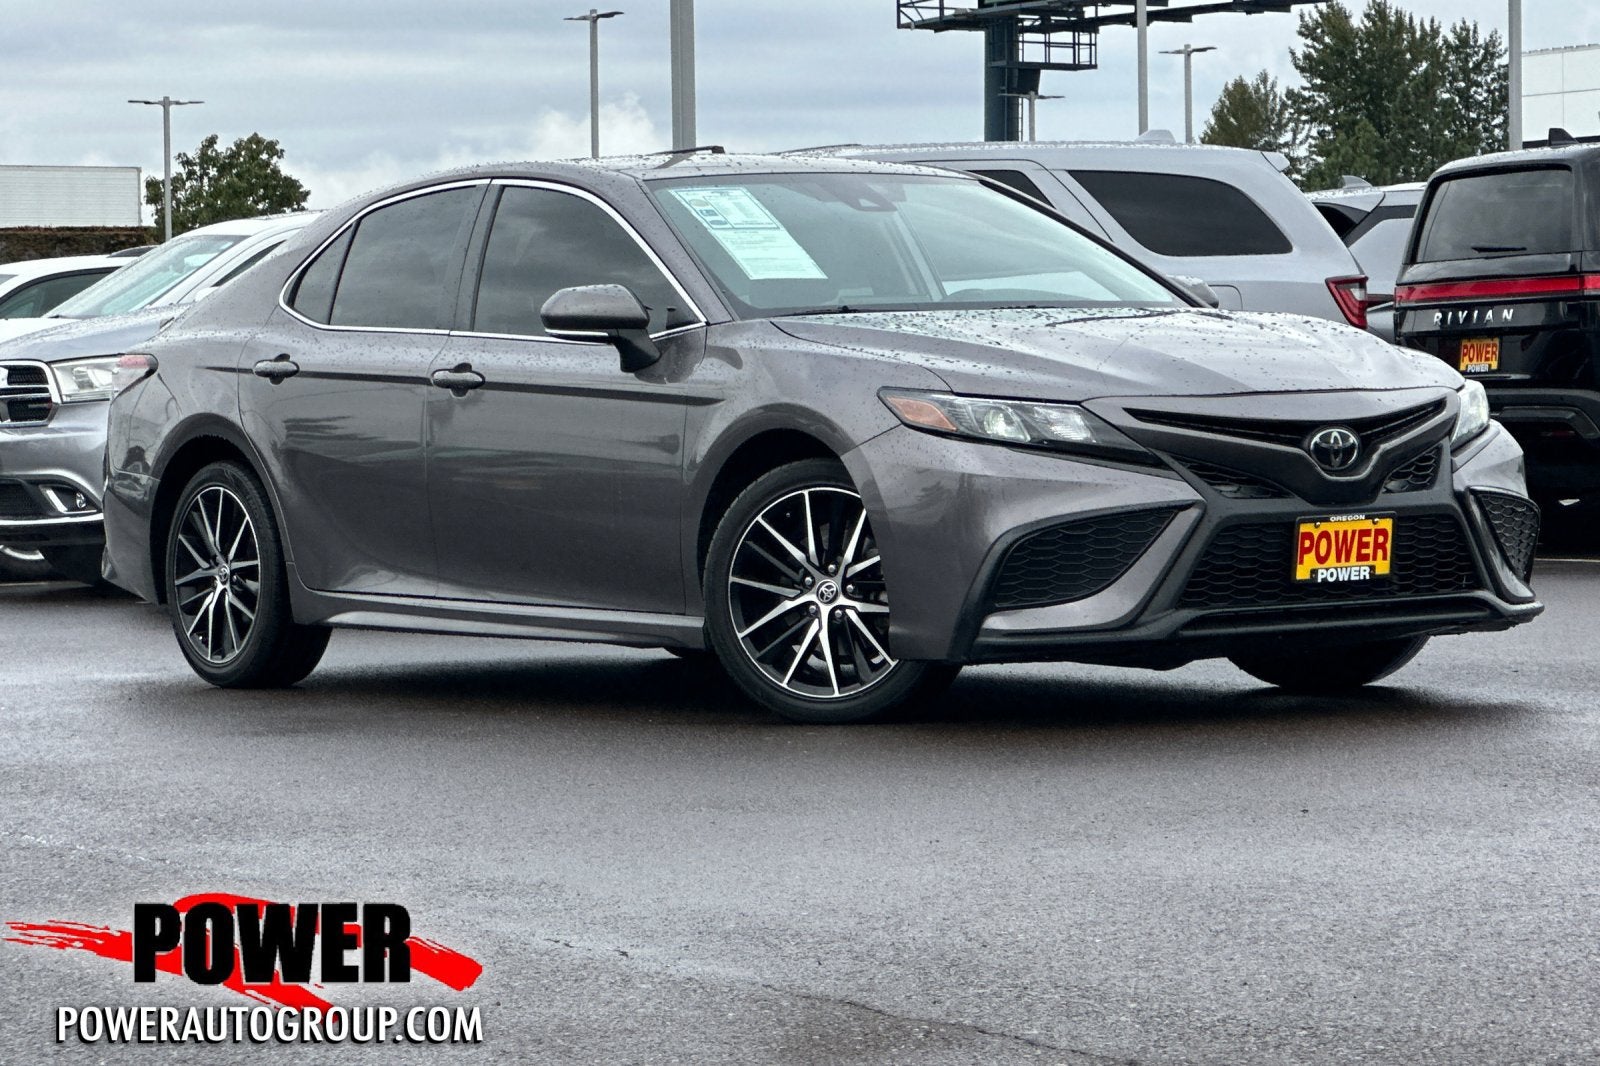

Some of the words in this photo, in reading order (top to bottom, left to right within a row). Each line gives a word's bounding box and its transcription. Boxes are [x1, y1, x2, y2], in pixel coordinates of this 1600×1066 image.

[1433, 309, 1514, 326] RIVIAN
[1462, 343, 1498, 362] POWER
[1467, 364, 1489, 373] POWER
[1329, 514, 1366, 522] OREGON
[1298, 528, 1389, 565] POWER
[1317, 566, 1370, 583] POWER
